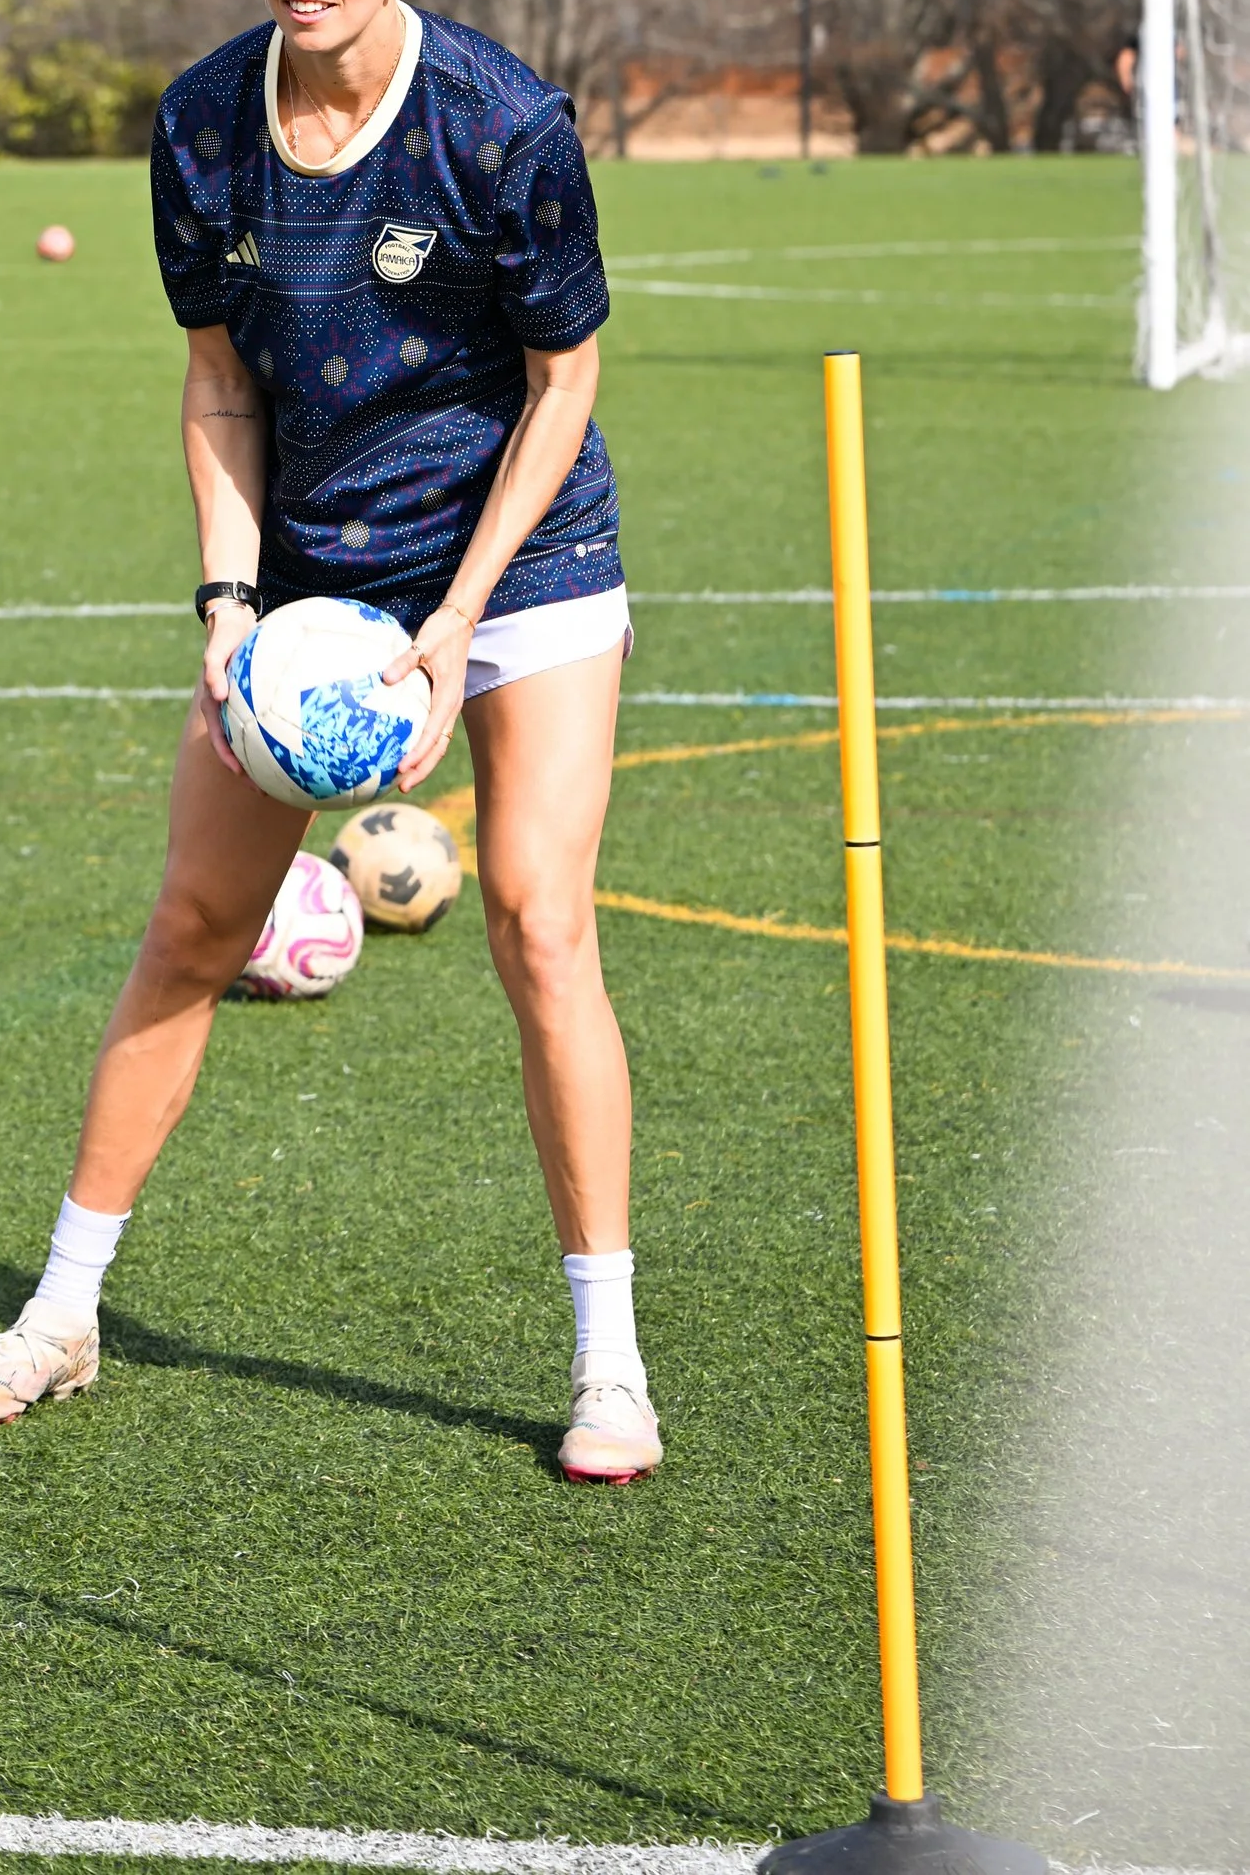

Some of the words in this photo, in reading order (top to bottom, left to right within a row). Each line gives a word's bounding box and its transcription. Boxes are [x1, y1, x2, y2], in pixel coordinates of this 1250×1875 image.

[384, 243, 410, 253] FOOTBALL
[379, 253, 415, 266] JAMAICA
[383, 265, 410, 276] FEDERATION
